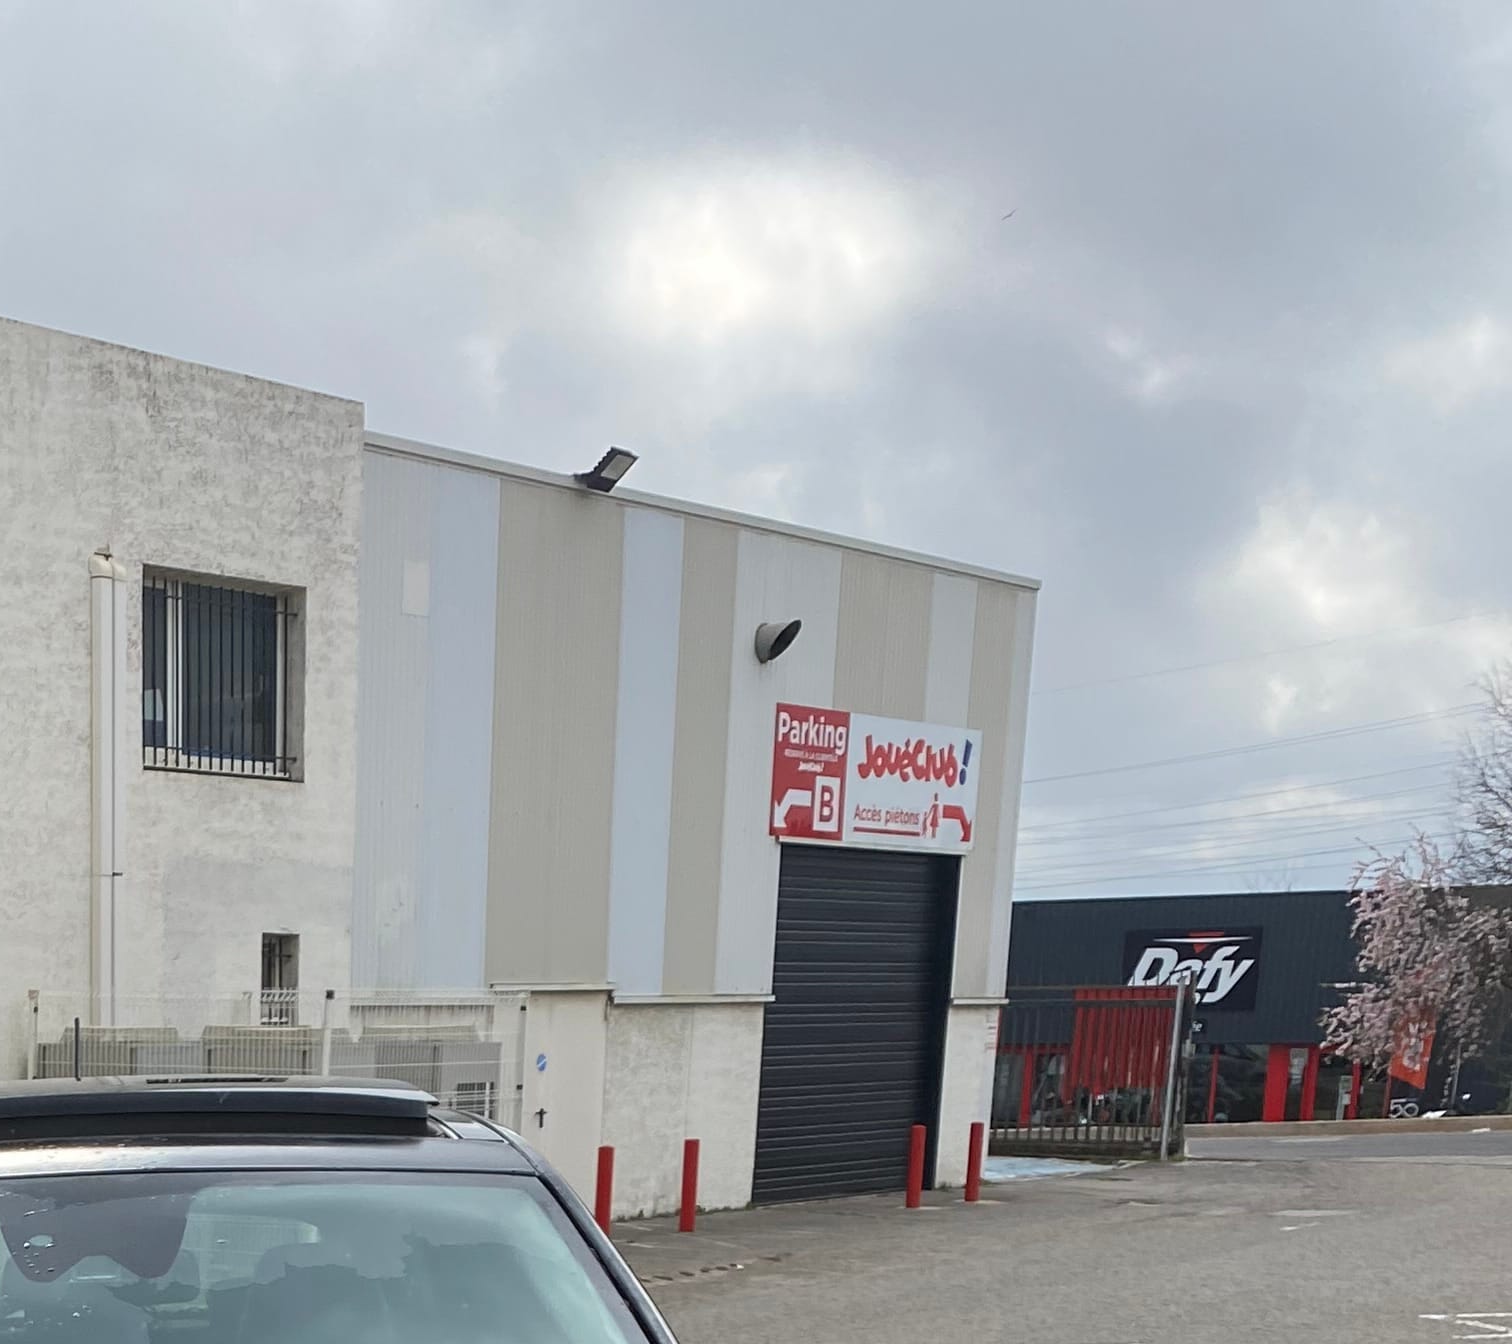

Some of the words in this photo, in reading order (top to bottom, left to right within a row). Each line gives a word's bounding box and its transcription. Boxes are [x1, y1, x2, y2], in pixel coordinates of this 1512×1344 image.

[778, 711, 848, 756] Parking
[857, 734, 973, 788] JouéClub!
[819, 784, 834, 823] B
[854, 804, 882, 822] Accès
[885, 807, 921, 828] piétons
[1128, 945, 1255, 1003] Dafy
